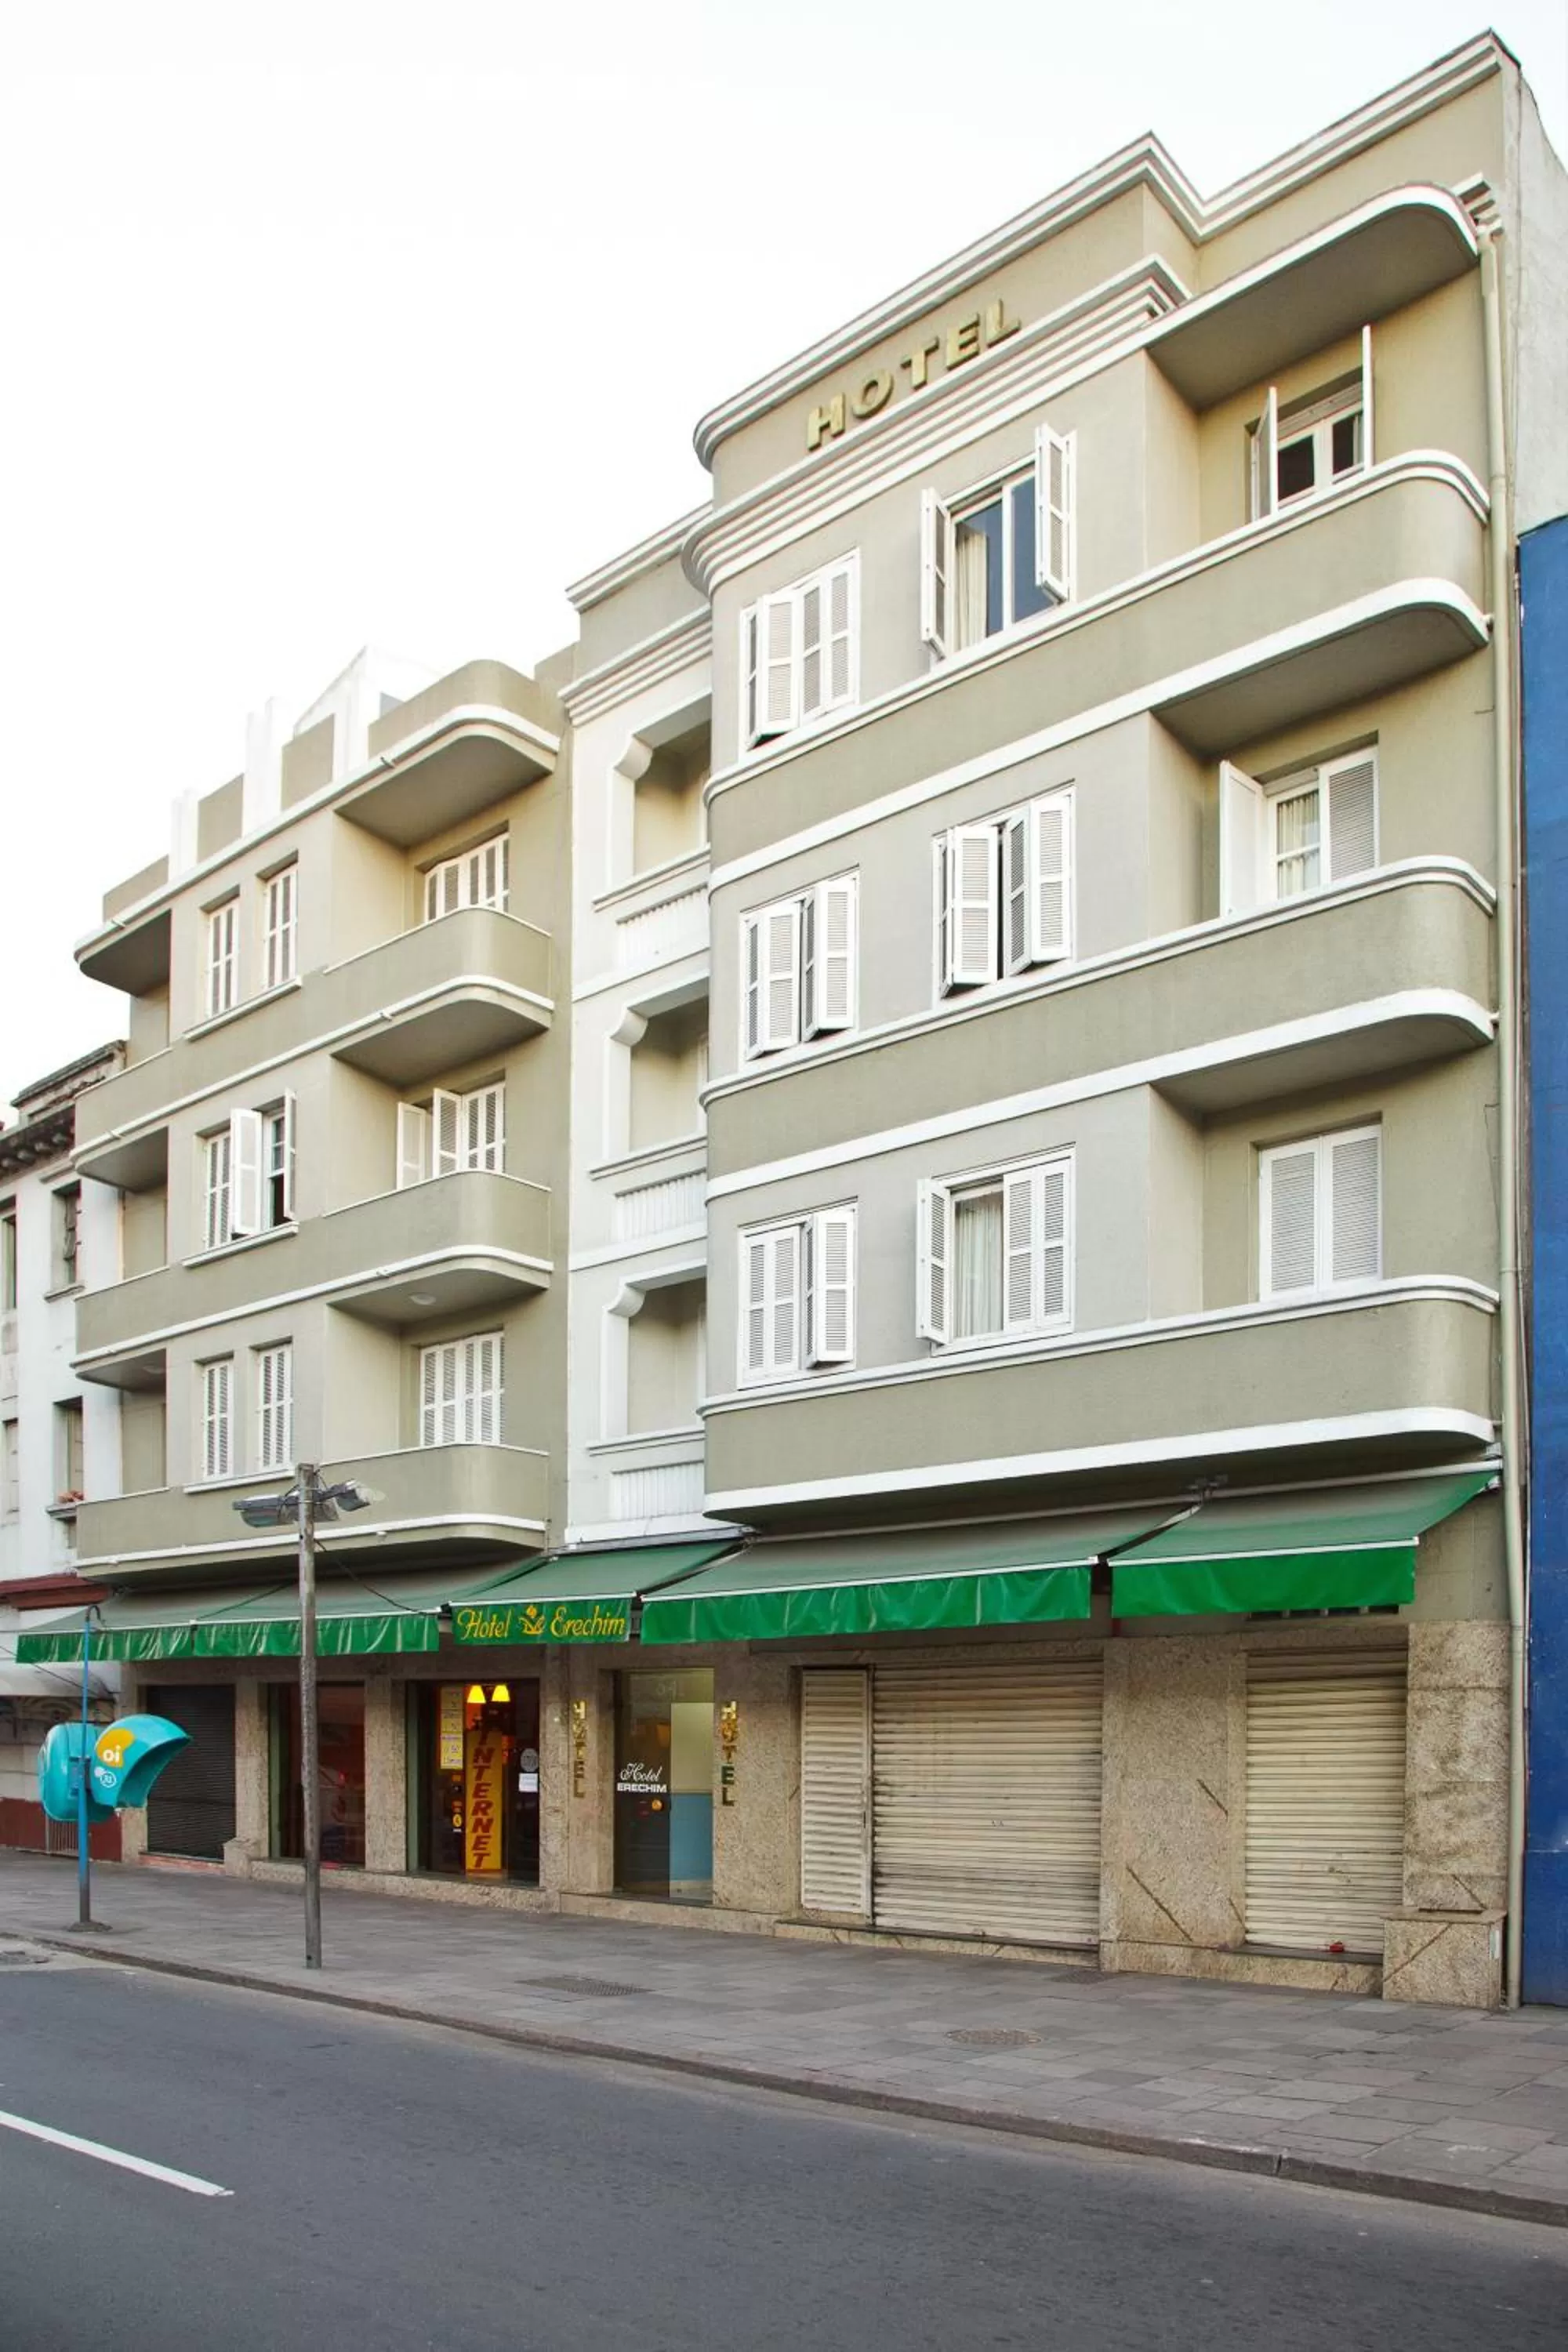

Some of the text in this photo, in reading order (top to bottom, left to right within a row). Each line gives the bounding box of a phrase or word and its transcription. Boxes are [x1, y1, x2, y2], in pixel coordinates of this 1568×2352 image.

[806, 298, 1021, 452] HOTEL
[457, 1606, 625, 1639] Hotel Erechim
[103, 1745, 120, 1762] oi
[720, 1700, 738, 1806] HOTEL
[617, 1783, 666, 1793] ERECHIM
[620, 1762, 662, 1782] Hotel
[472, 1728, 495, 1868] INTERNET
